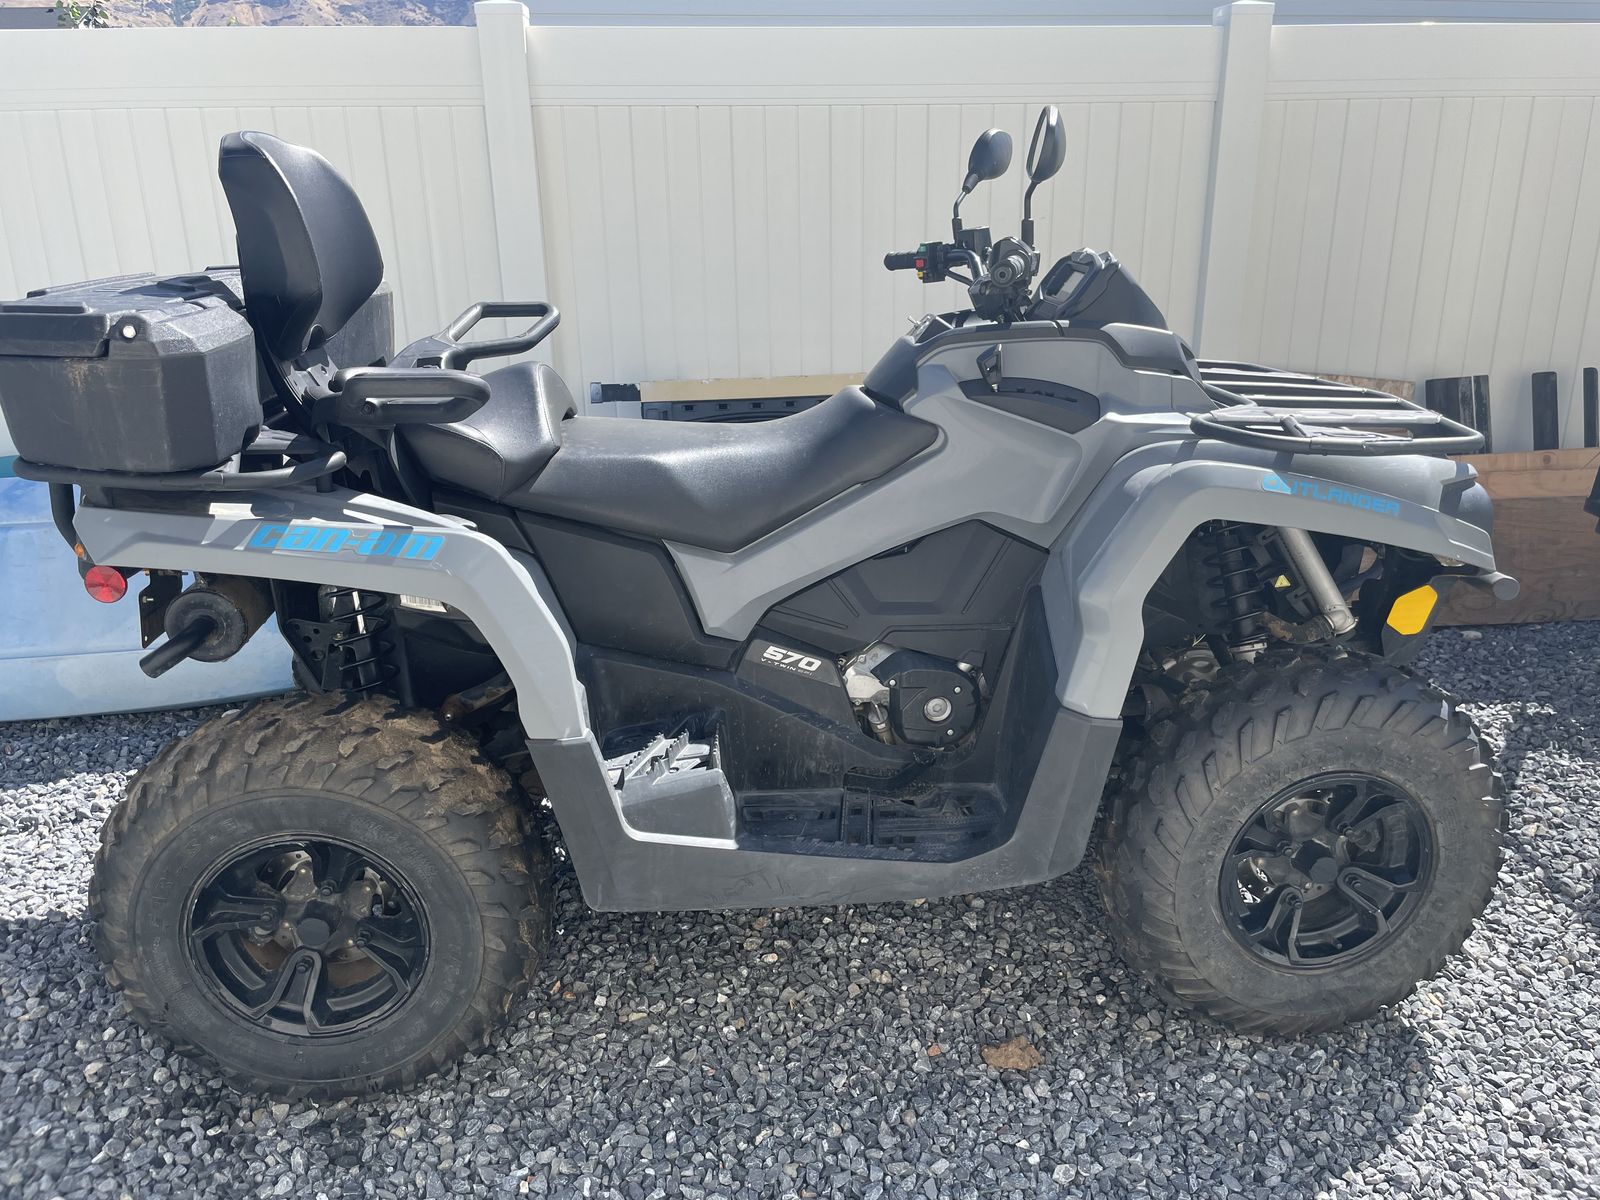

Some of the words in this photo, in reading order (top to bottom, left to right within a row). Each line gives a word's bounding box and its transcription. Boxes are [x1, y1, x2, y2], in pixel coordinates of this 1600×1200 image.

[1263, 474, 1400, 515] OUTLANDER
[250, 525, 445, 560] can-am
[763, 646, 822, 671] 570
